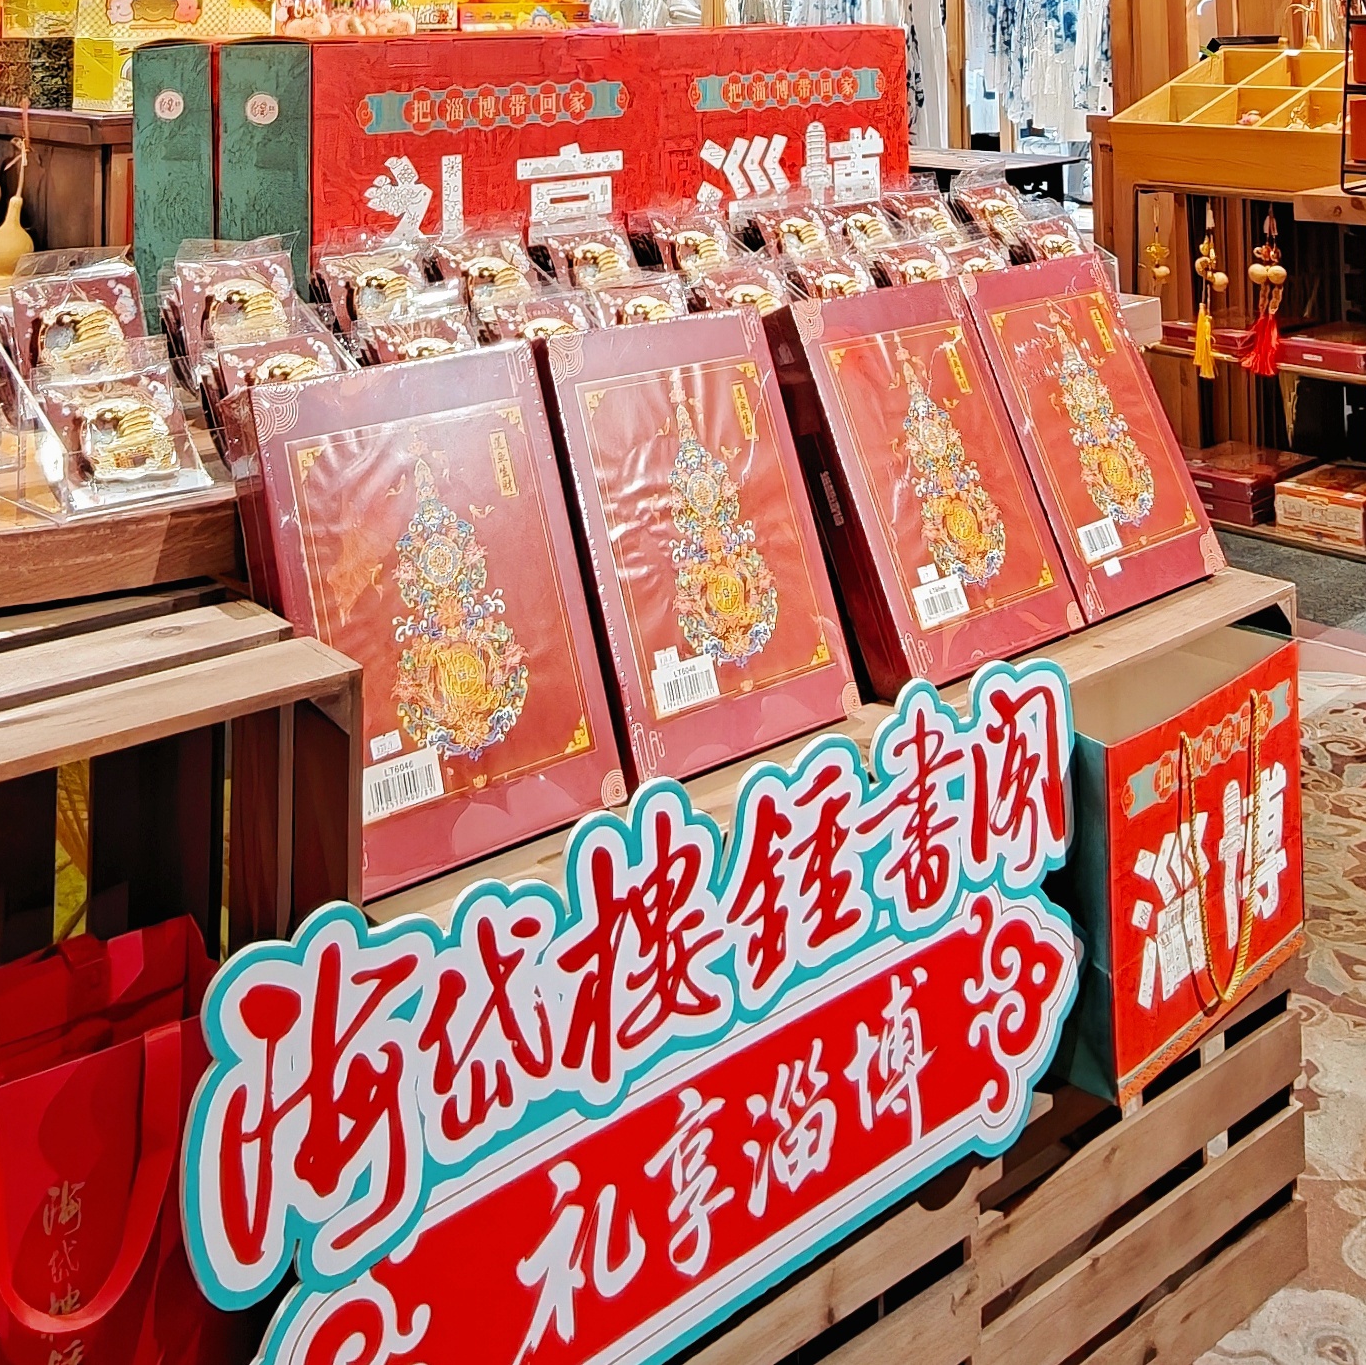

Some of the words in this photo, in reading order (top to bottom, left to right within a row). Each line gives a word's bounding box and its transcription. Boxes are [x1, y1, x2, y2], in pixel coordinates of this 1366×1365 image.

[411, 90, 592, 125] 把淄博带回家
[727, 75, 857, 105] 把淄博带回家
[517, 974, 935, 1365] 礼享淄博
